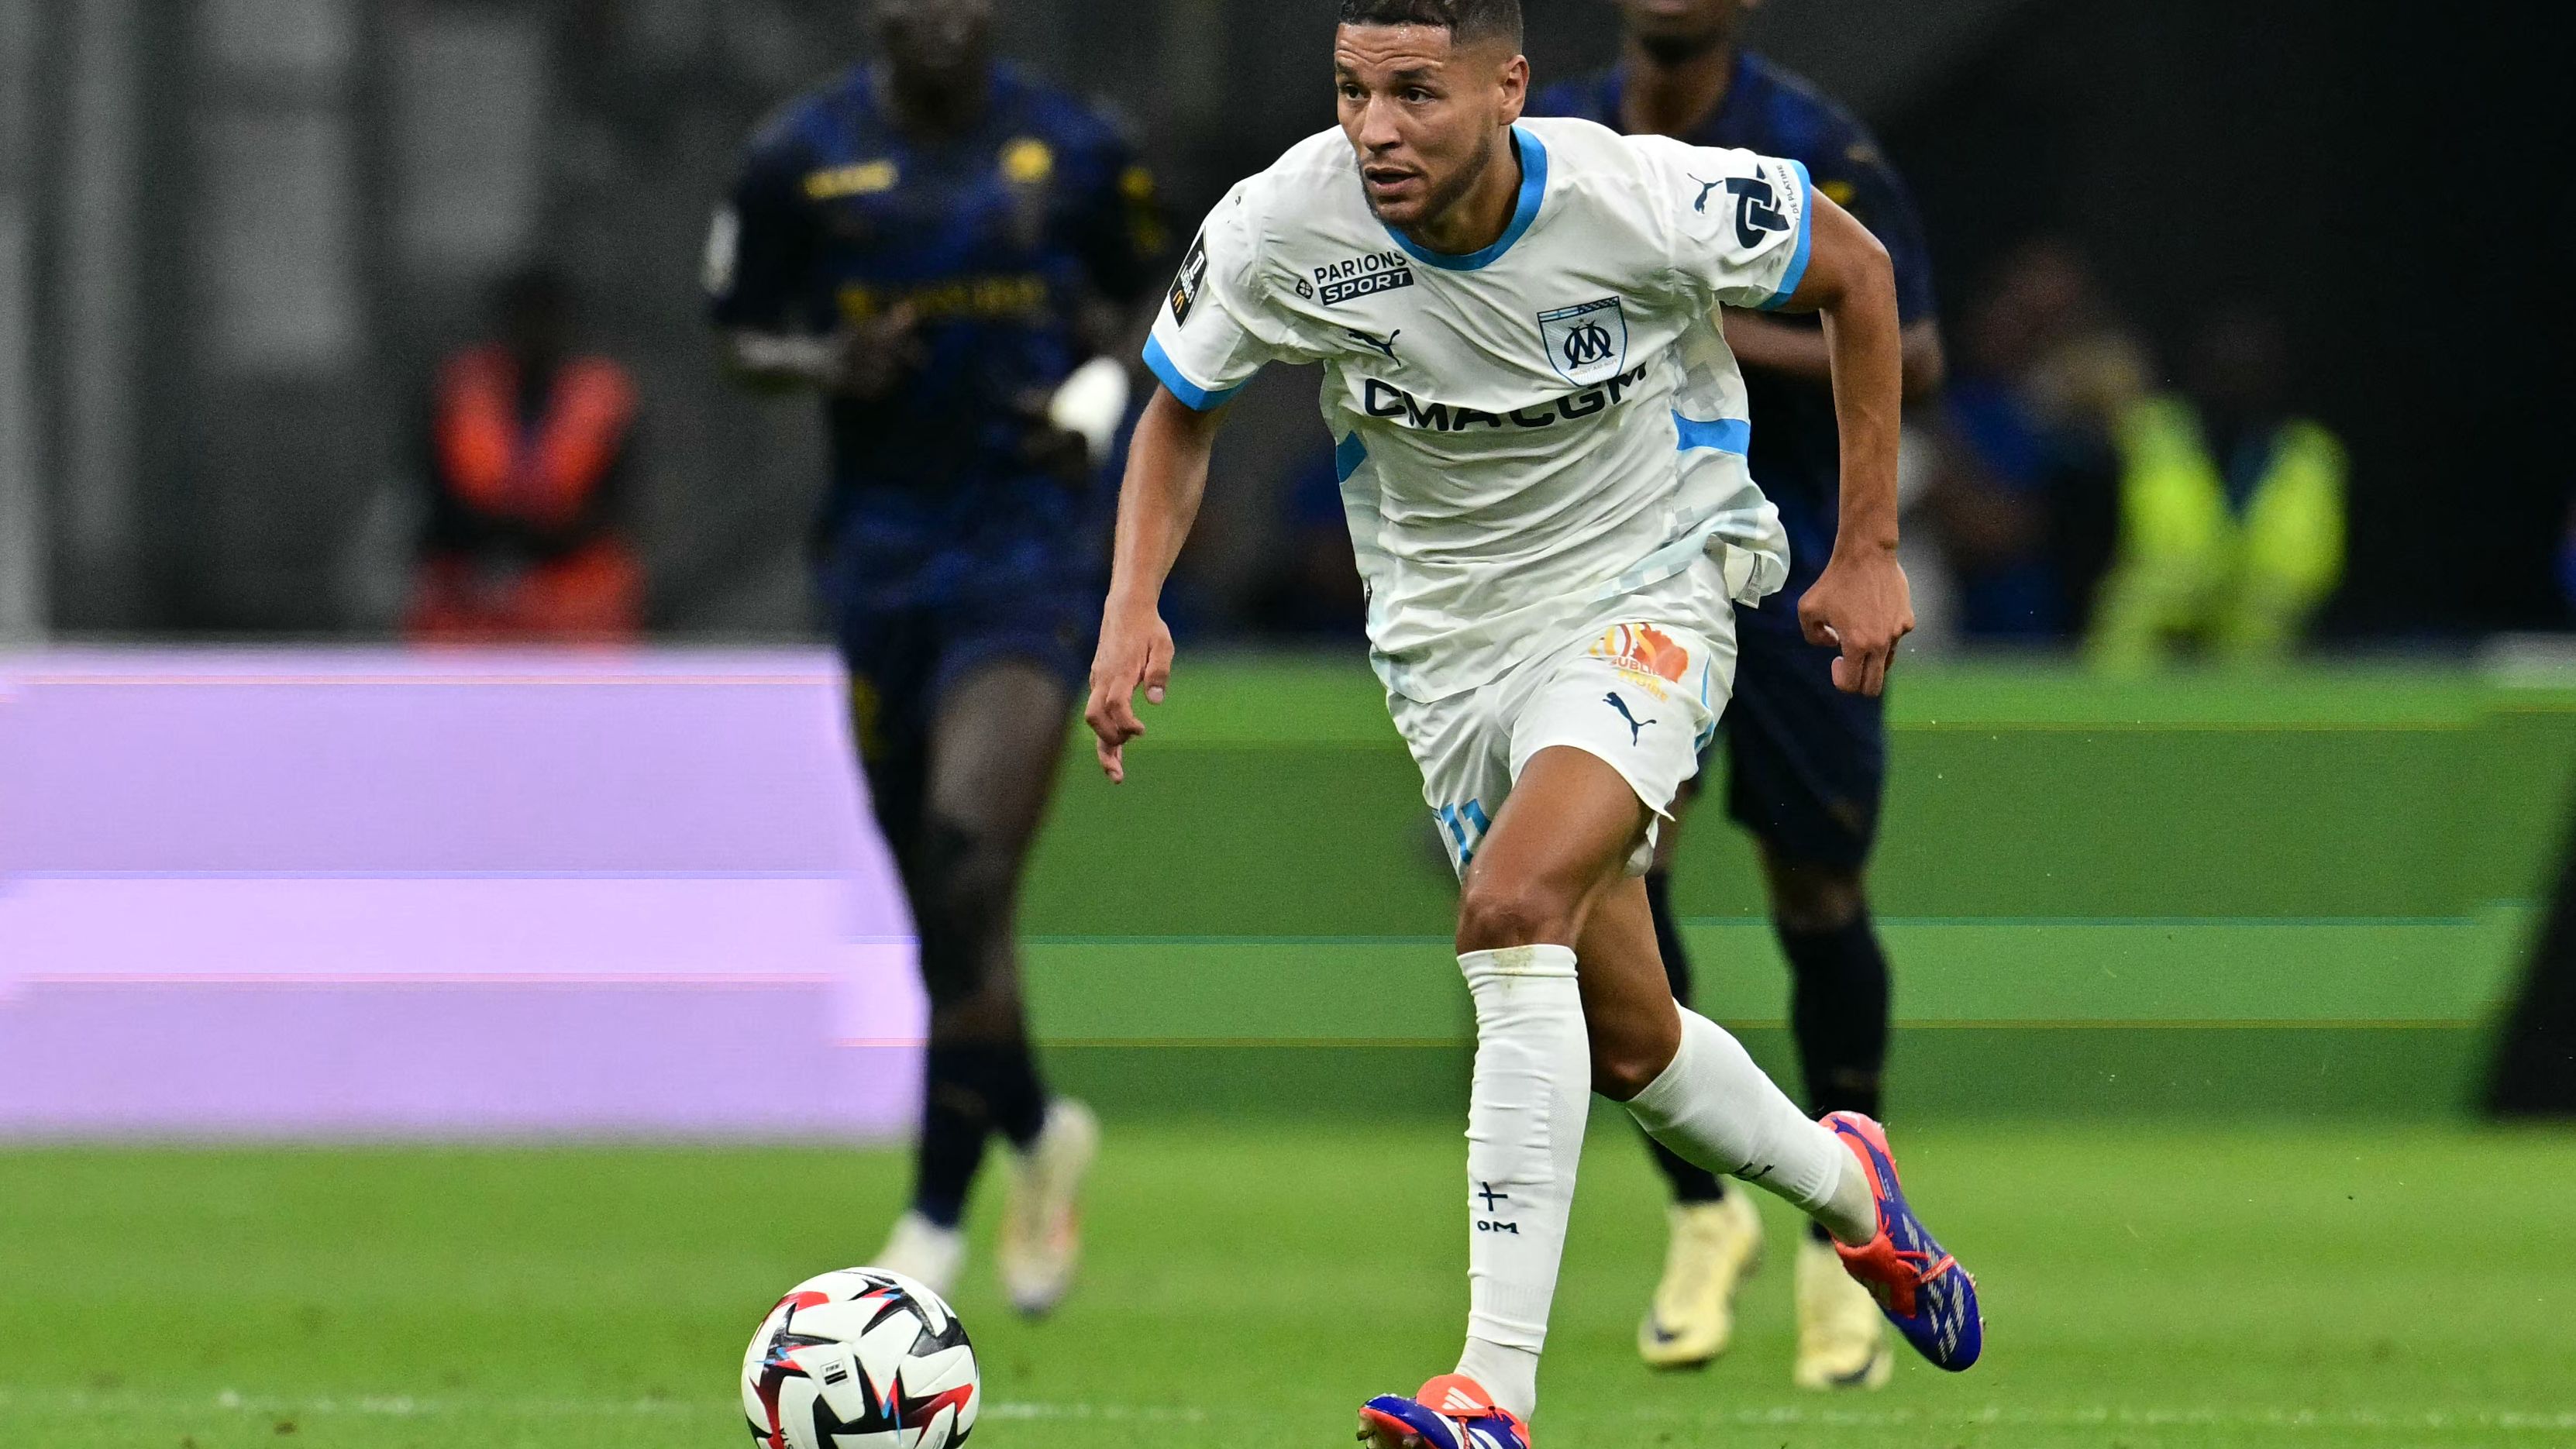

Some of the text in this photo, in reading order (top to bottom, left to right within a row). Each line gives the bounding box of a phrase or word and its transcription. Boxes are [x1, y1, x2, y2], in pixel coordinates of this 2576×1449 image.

[1314, 251, 1407, 285] PARIONS
[1325, 270, 1408, 302] SPORT
[1365, 362, 1647, 432] CMA CGM
